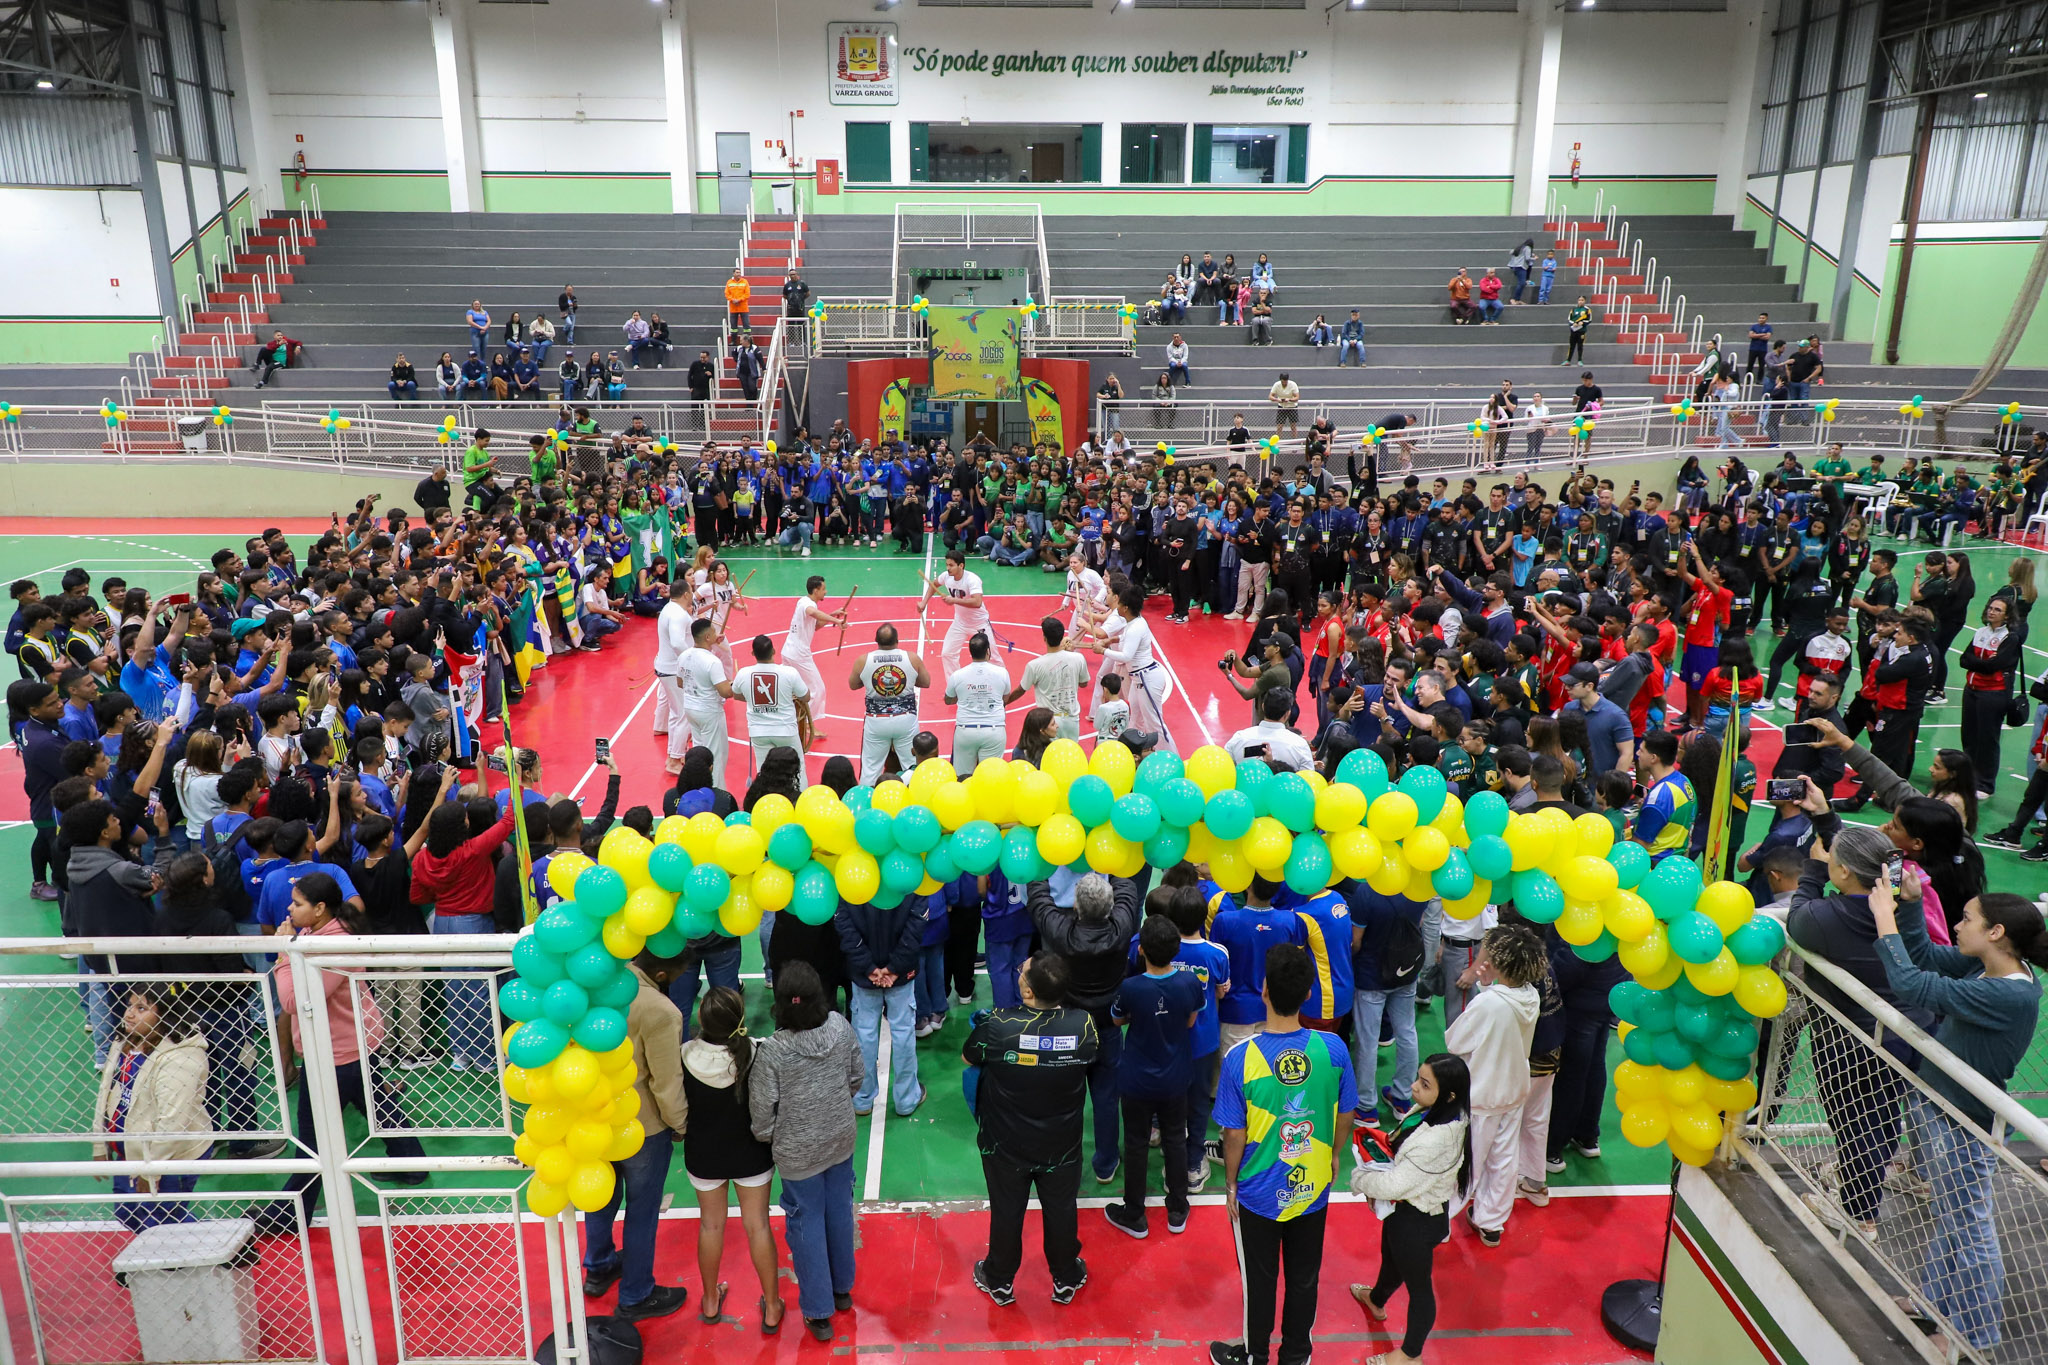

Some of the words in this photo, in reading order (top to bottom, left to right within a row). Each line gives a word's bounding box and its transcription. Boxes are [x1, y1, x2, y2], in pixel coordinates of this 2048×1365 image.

[940, 49, 989, 77] pode
[991, 50, 1067, 77] ganhar
[1071, 54, 1127, 78] quem
[1131, 50, 1199, 74] souber
[835, 89, 863, 97] VÁRZEA
[1275, 84, 1305, 96] Campos
[943, 352, 972, 361] JOGOS
[979, 346, 1004, 359] JOGOS
[885, 414, 901, 422] JOGOS
[1290, 1050, 1305, 1058] ATIVA
[1276, 1181, 1315, 1201] Capital
